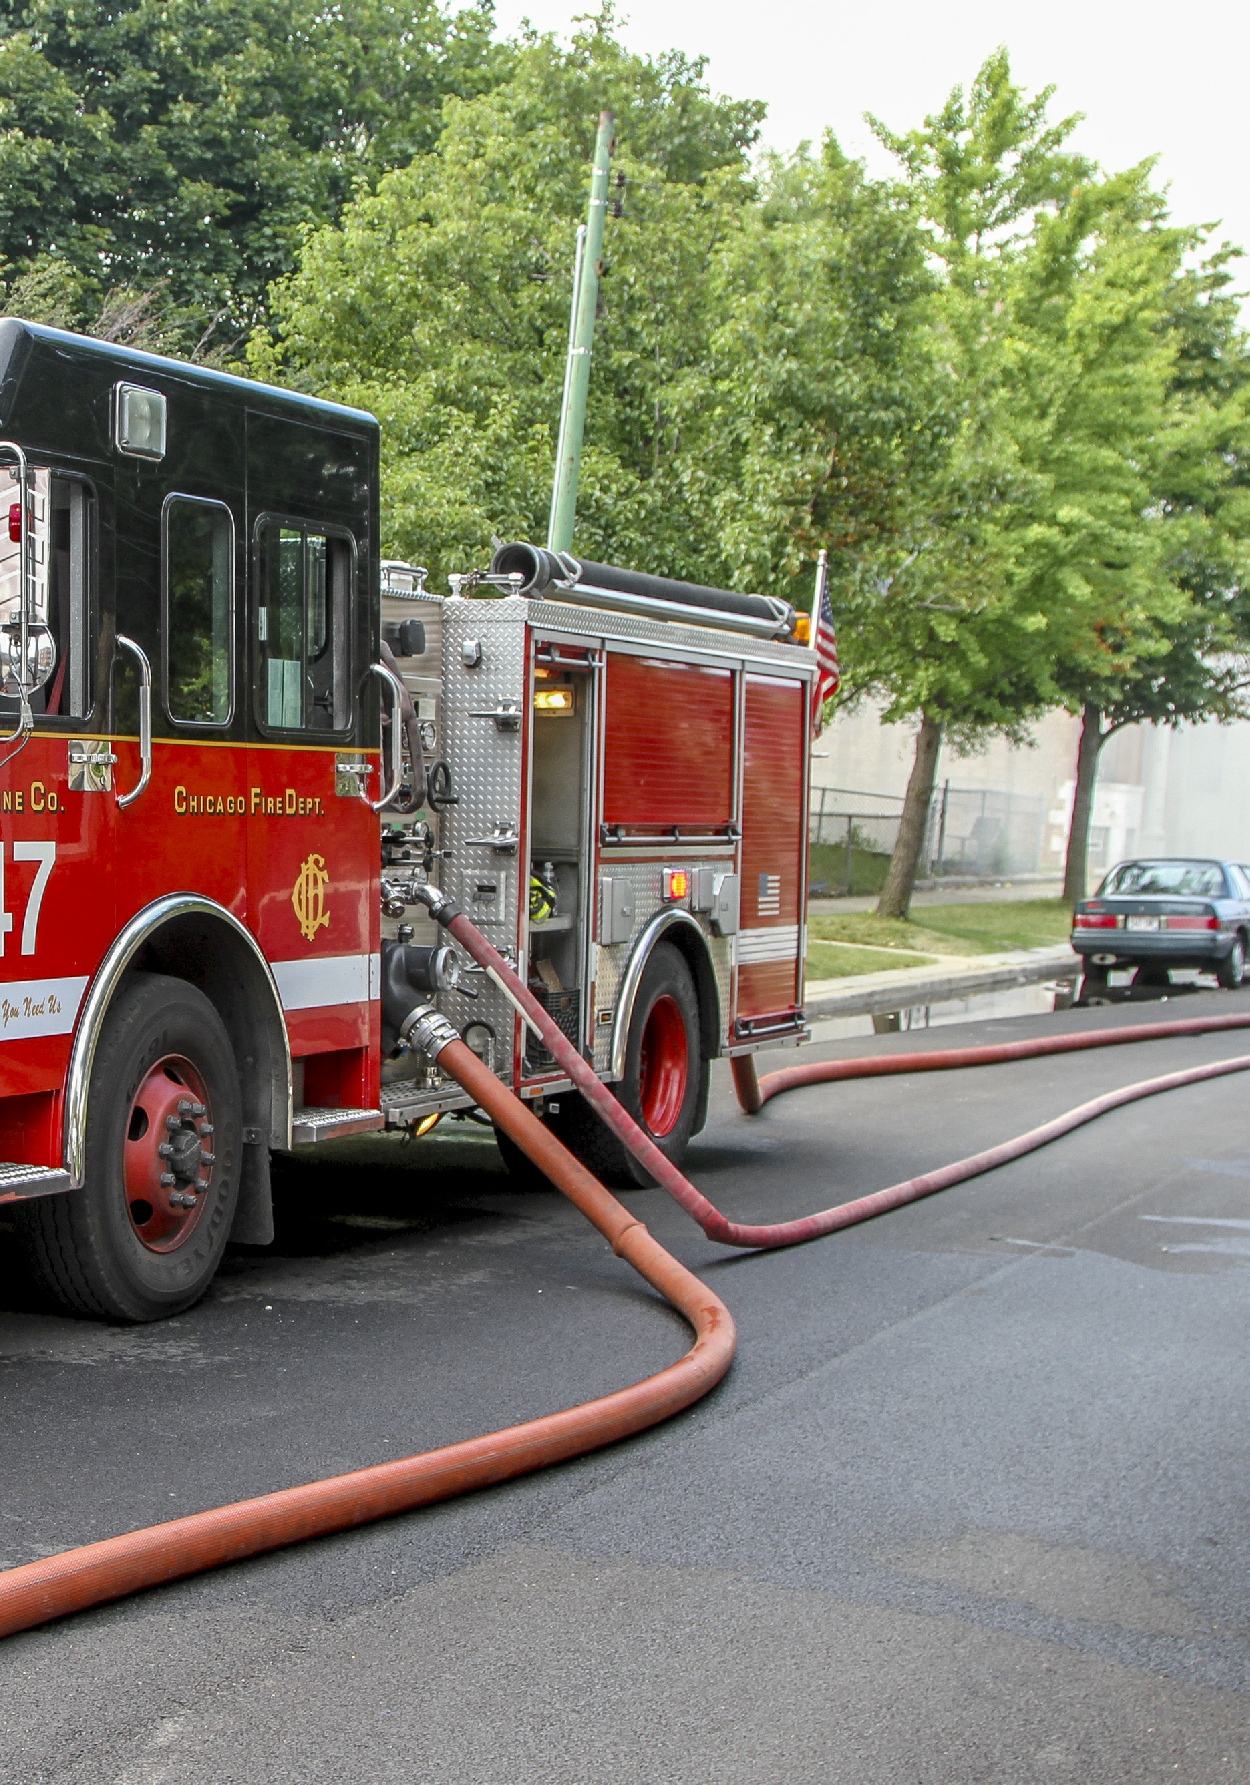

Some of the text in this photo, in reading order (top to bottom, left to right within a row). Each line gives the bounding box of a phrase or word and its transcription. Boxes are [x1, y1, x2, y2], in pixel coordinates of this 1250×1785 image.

[30, 781, 66, 815] CO.
[174, 785, 247, 815] CHICAGO
[1, 999, 20, 1028] You
[22, 997, 45, 1018] Need
[47, 994, 61, 1014] Us
